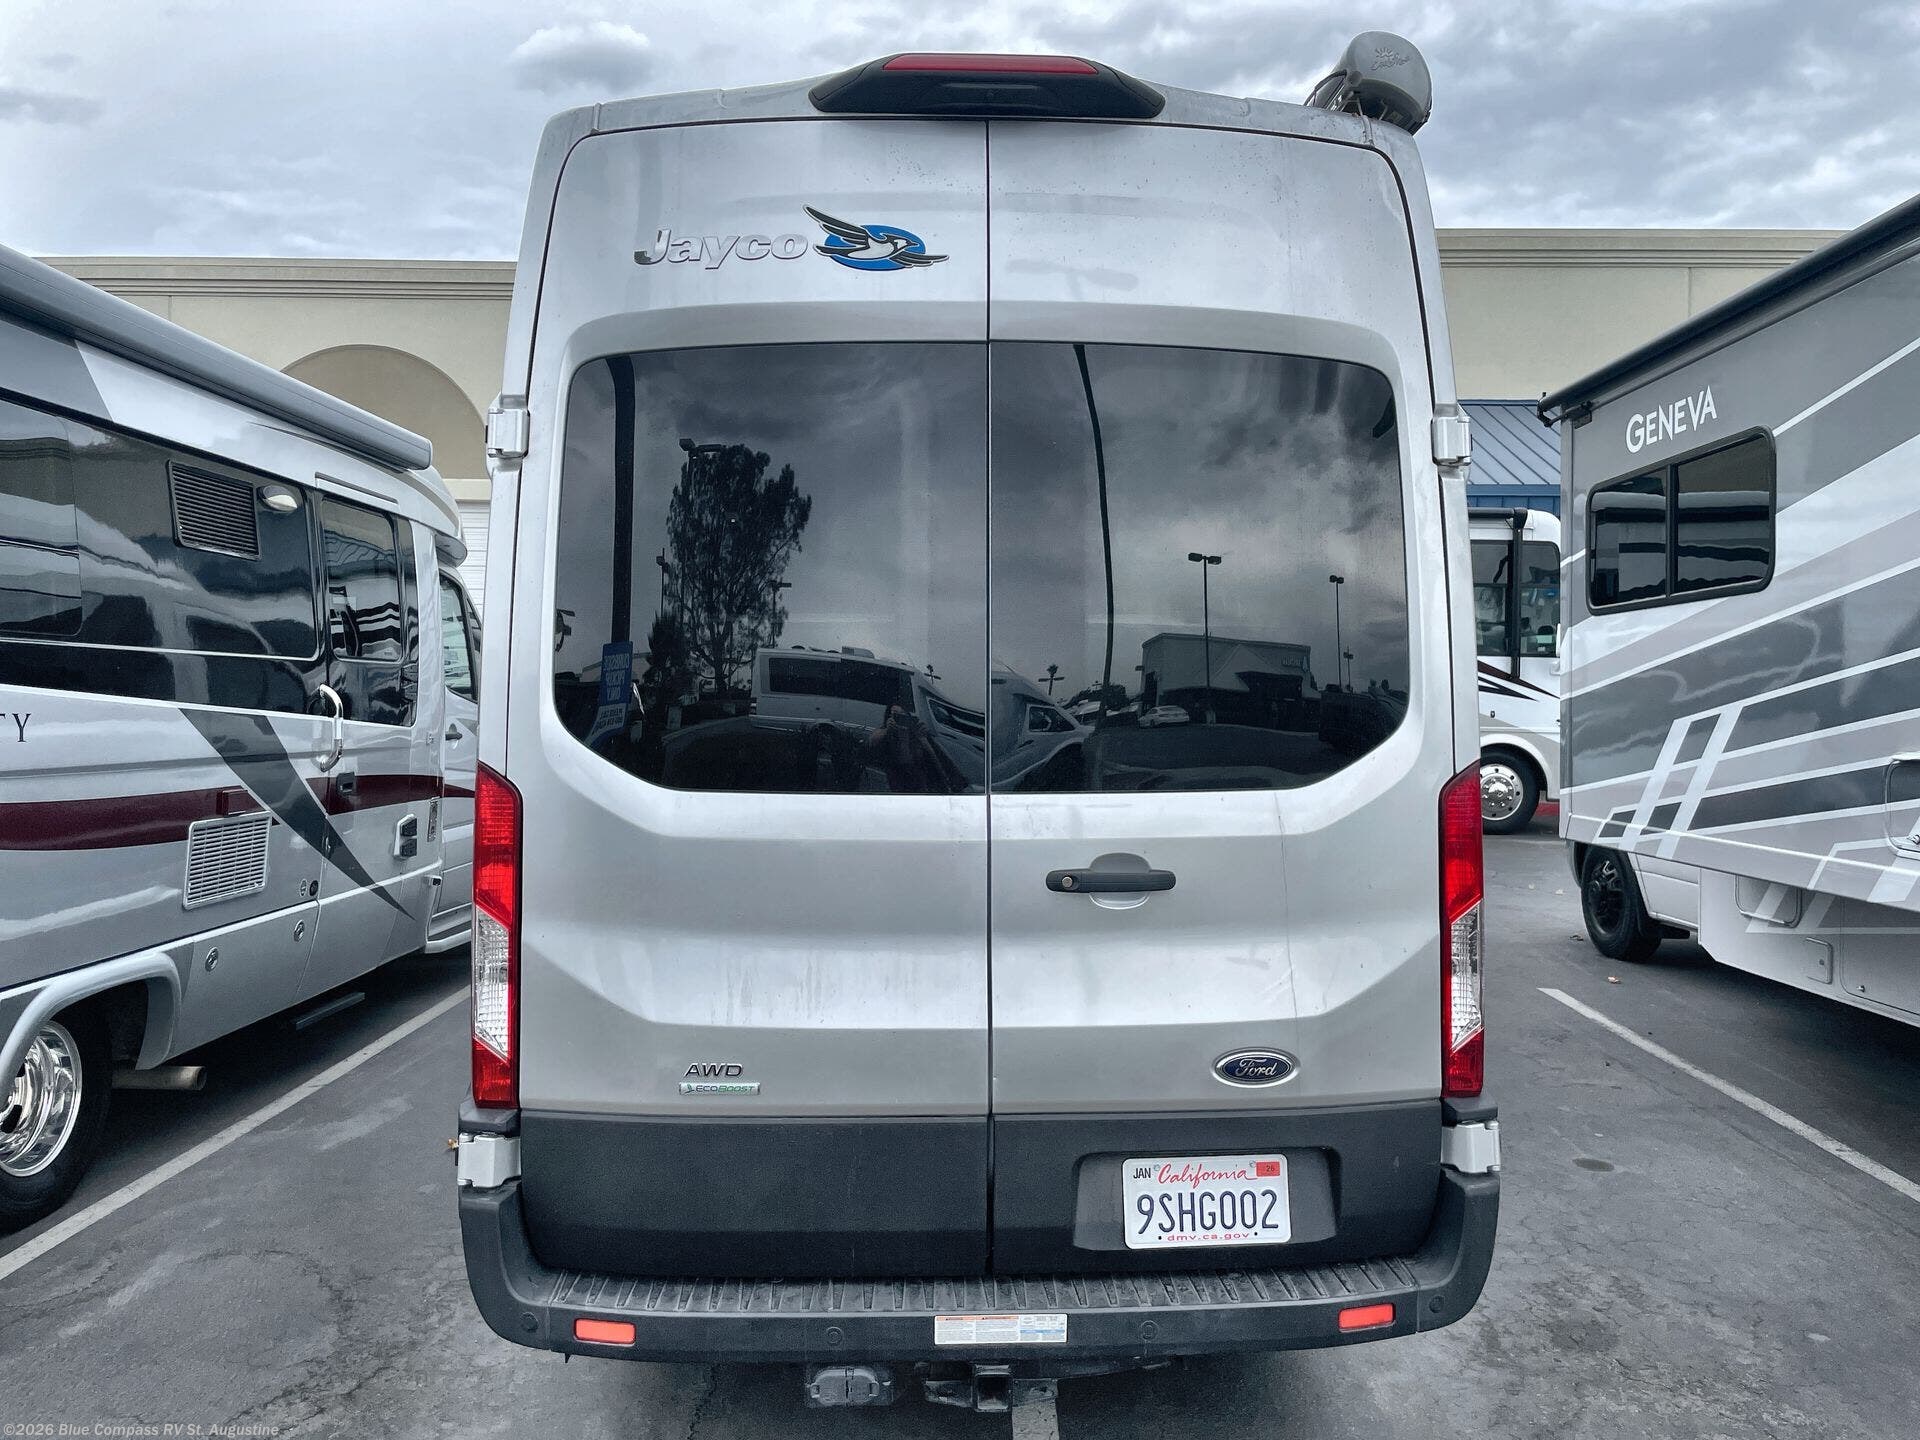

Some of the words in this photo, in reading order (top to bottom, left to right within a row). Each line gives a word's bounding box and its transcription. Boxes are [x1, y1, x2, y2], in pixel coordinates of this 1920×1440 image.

[633, 228, 809, 270] Jayco
[1626, 384, 1718, 454] GENEVA
[683, 1062, 743, 1077] AWD
[1235, 1058, 1277, 1076] Ford
[1133, 1167, 1151, 1179] JAN
[1158, 1163, 1258, 1189] California
[1136, 1189, 1279, 1235] 9SHG002
[1167, 1232, 1250, 1241] dmv.ca.gov
